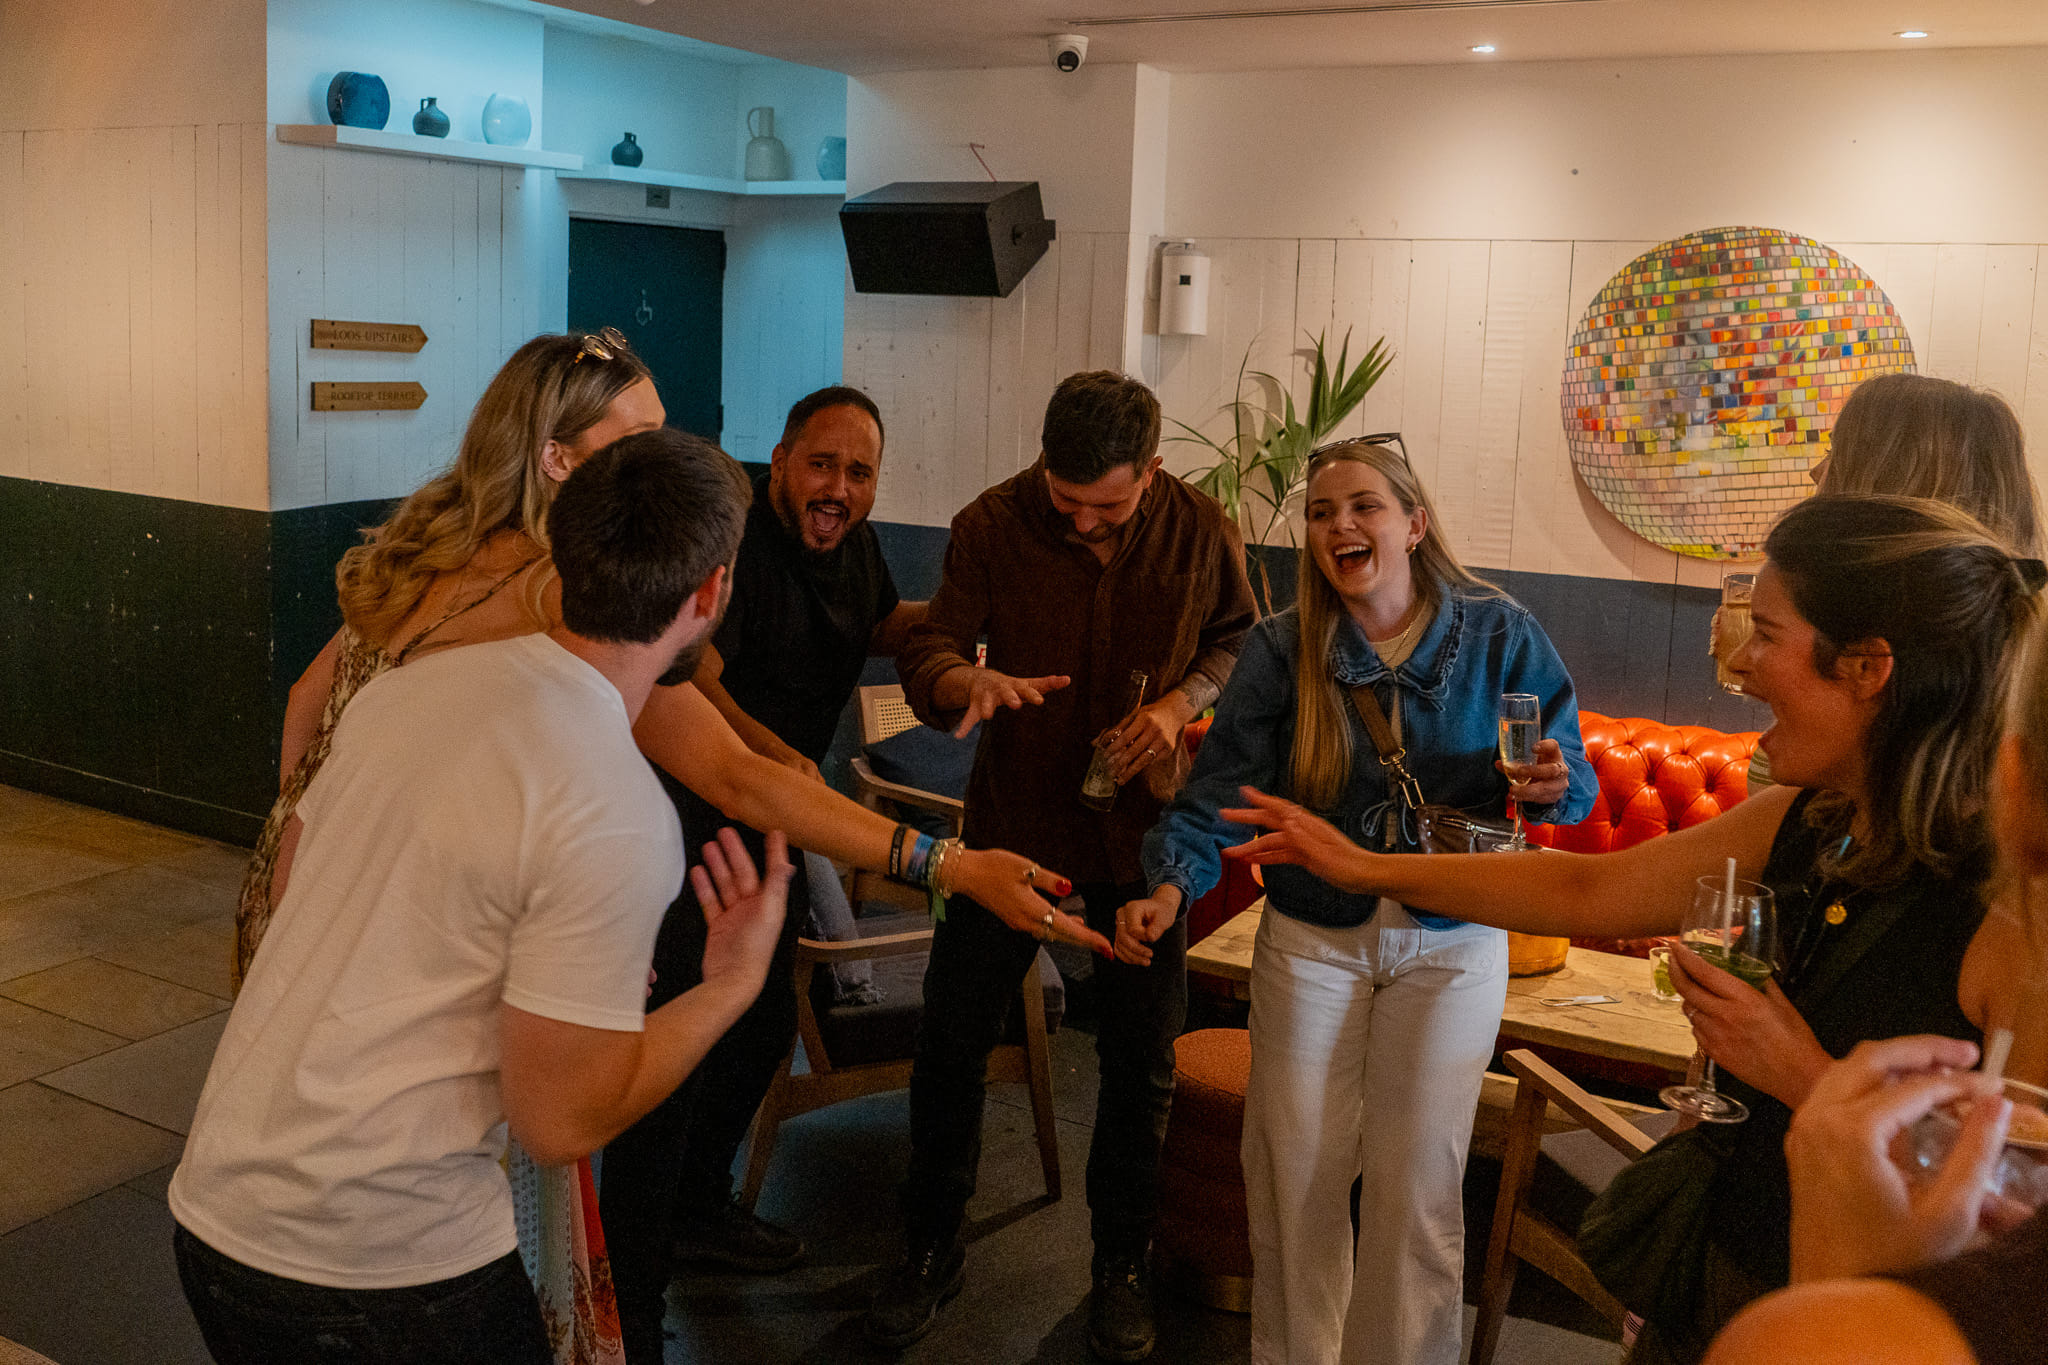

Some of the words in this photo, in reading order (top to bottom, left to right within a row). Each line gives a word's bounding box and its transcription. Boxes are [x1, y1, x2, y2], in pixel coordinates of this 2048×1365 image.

[334, 330, 361, 341] LOOS
[365, 331, 414, 343] UPSTAIRS
[331, 391, 373, 401] ROOFTOP
[377, 391, 416, 401] TERRACE
